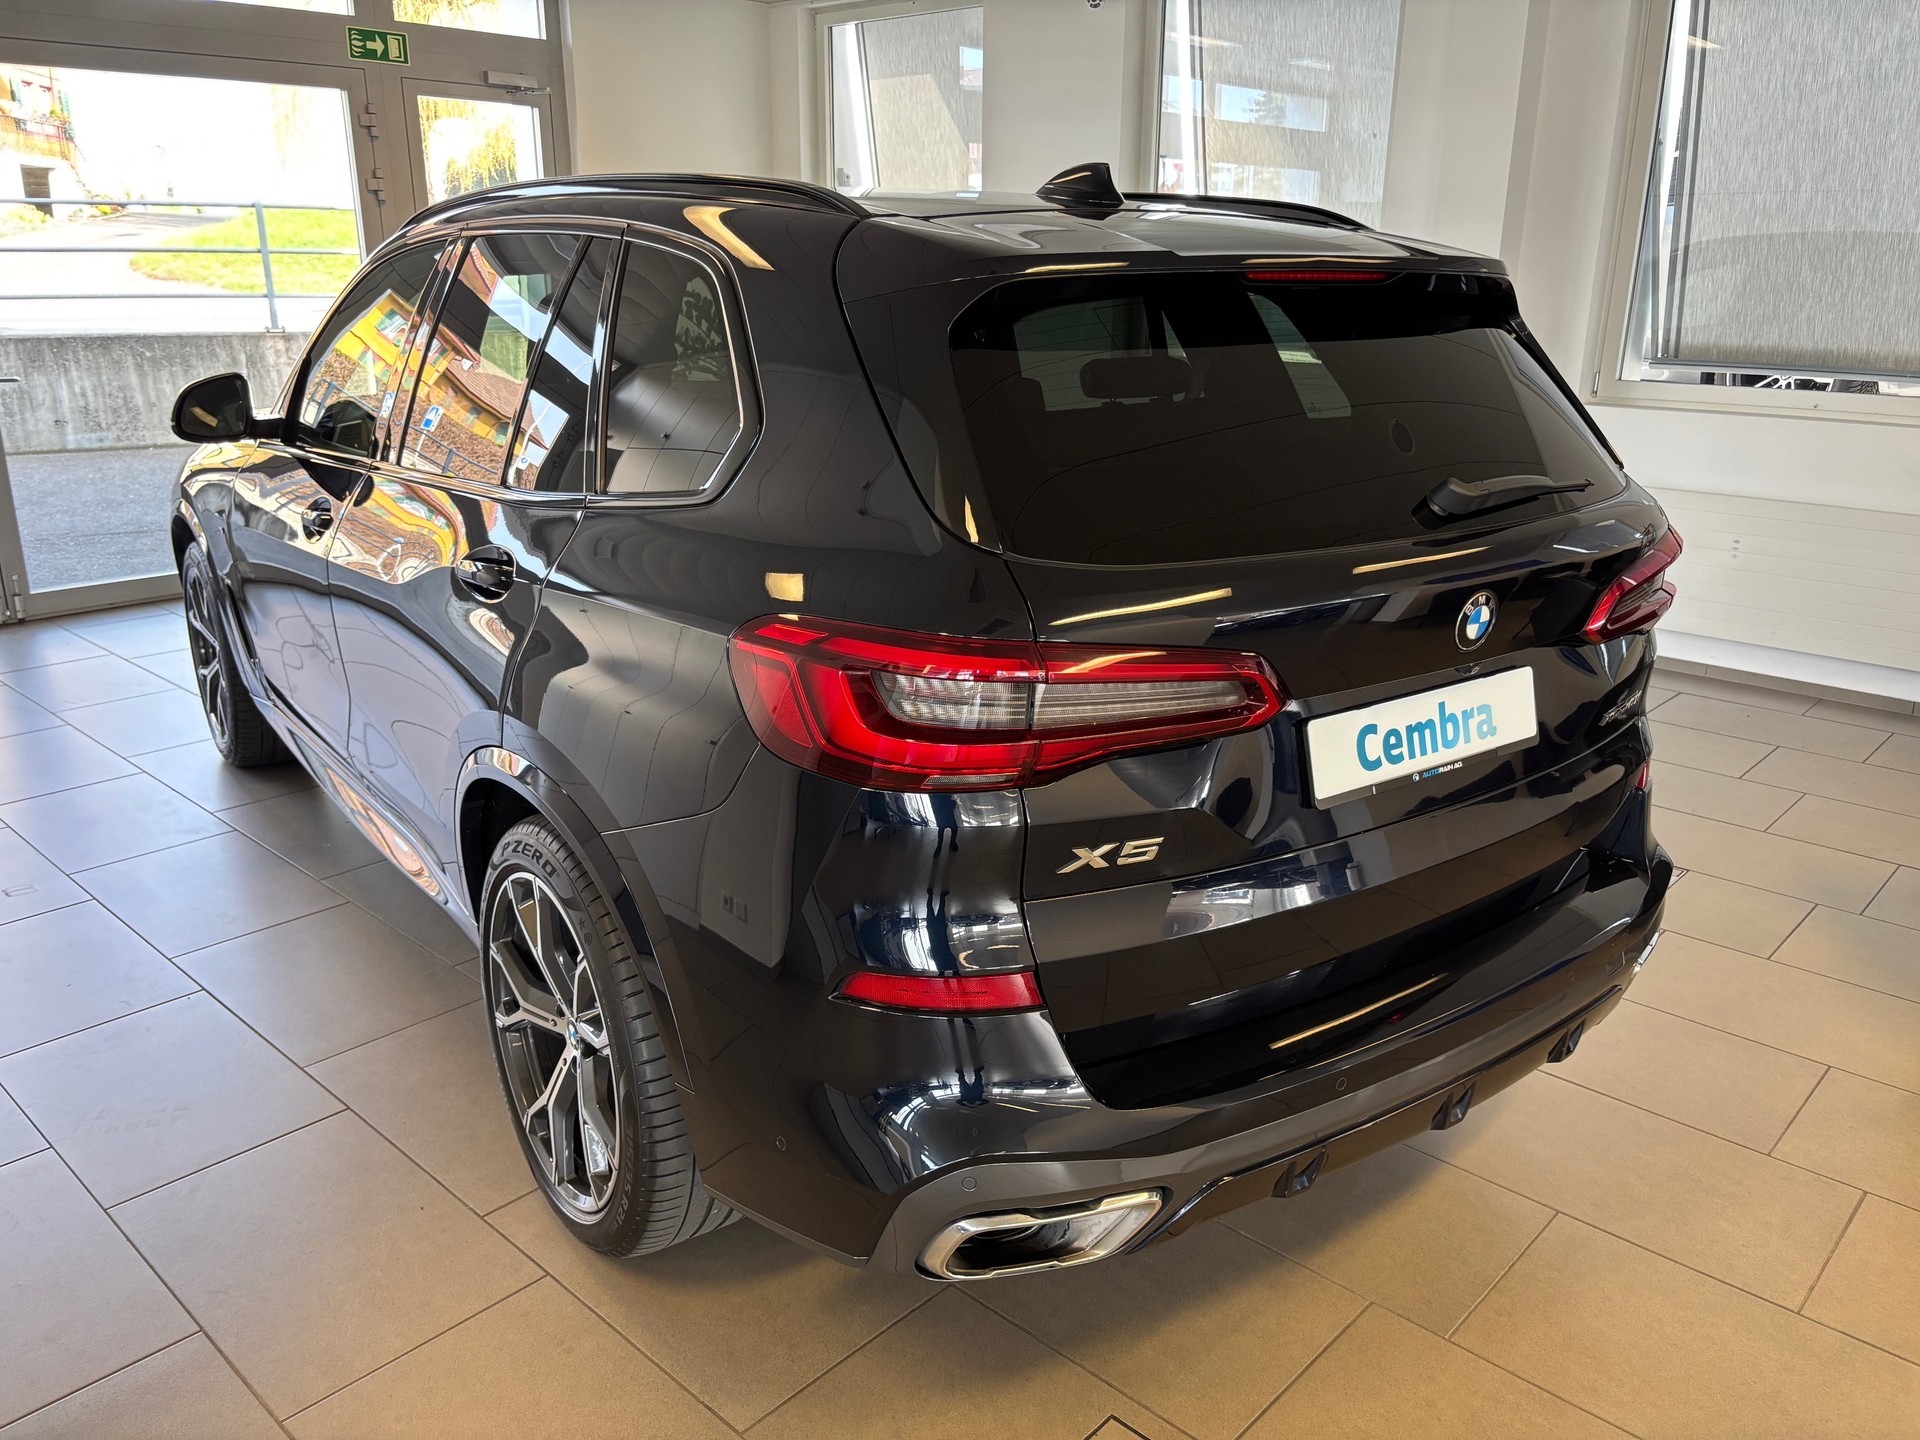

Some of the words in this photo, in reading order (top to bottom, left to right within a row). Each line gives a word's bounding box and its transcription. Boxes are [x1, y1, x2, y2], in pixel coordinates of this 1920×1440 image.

[1465, 595, 1494, 616] BMW
[1356, 701, 1497, 772] Cembra
[501, 841, 511, 857] P
[511, 840, 557, 878] ZERO
[1055, 836, 1165, 874] X5
